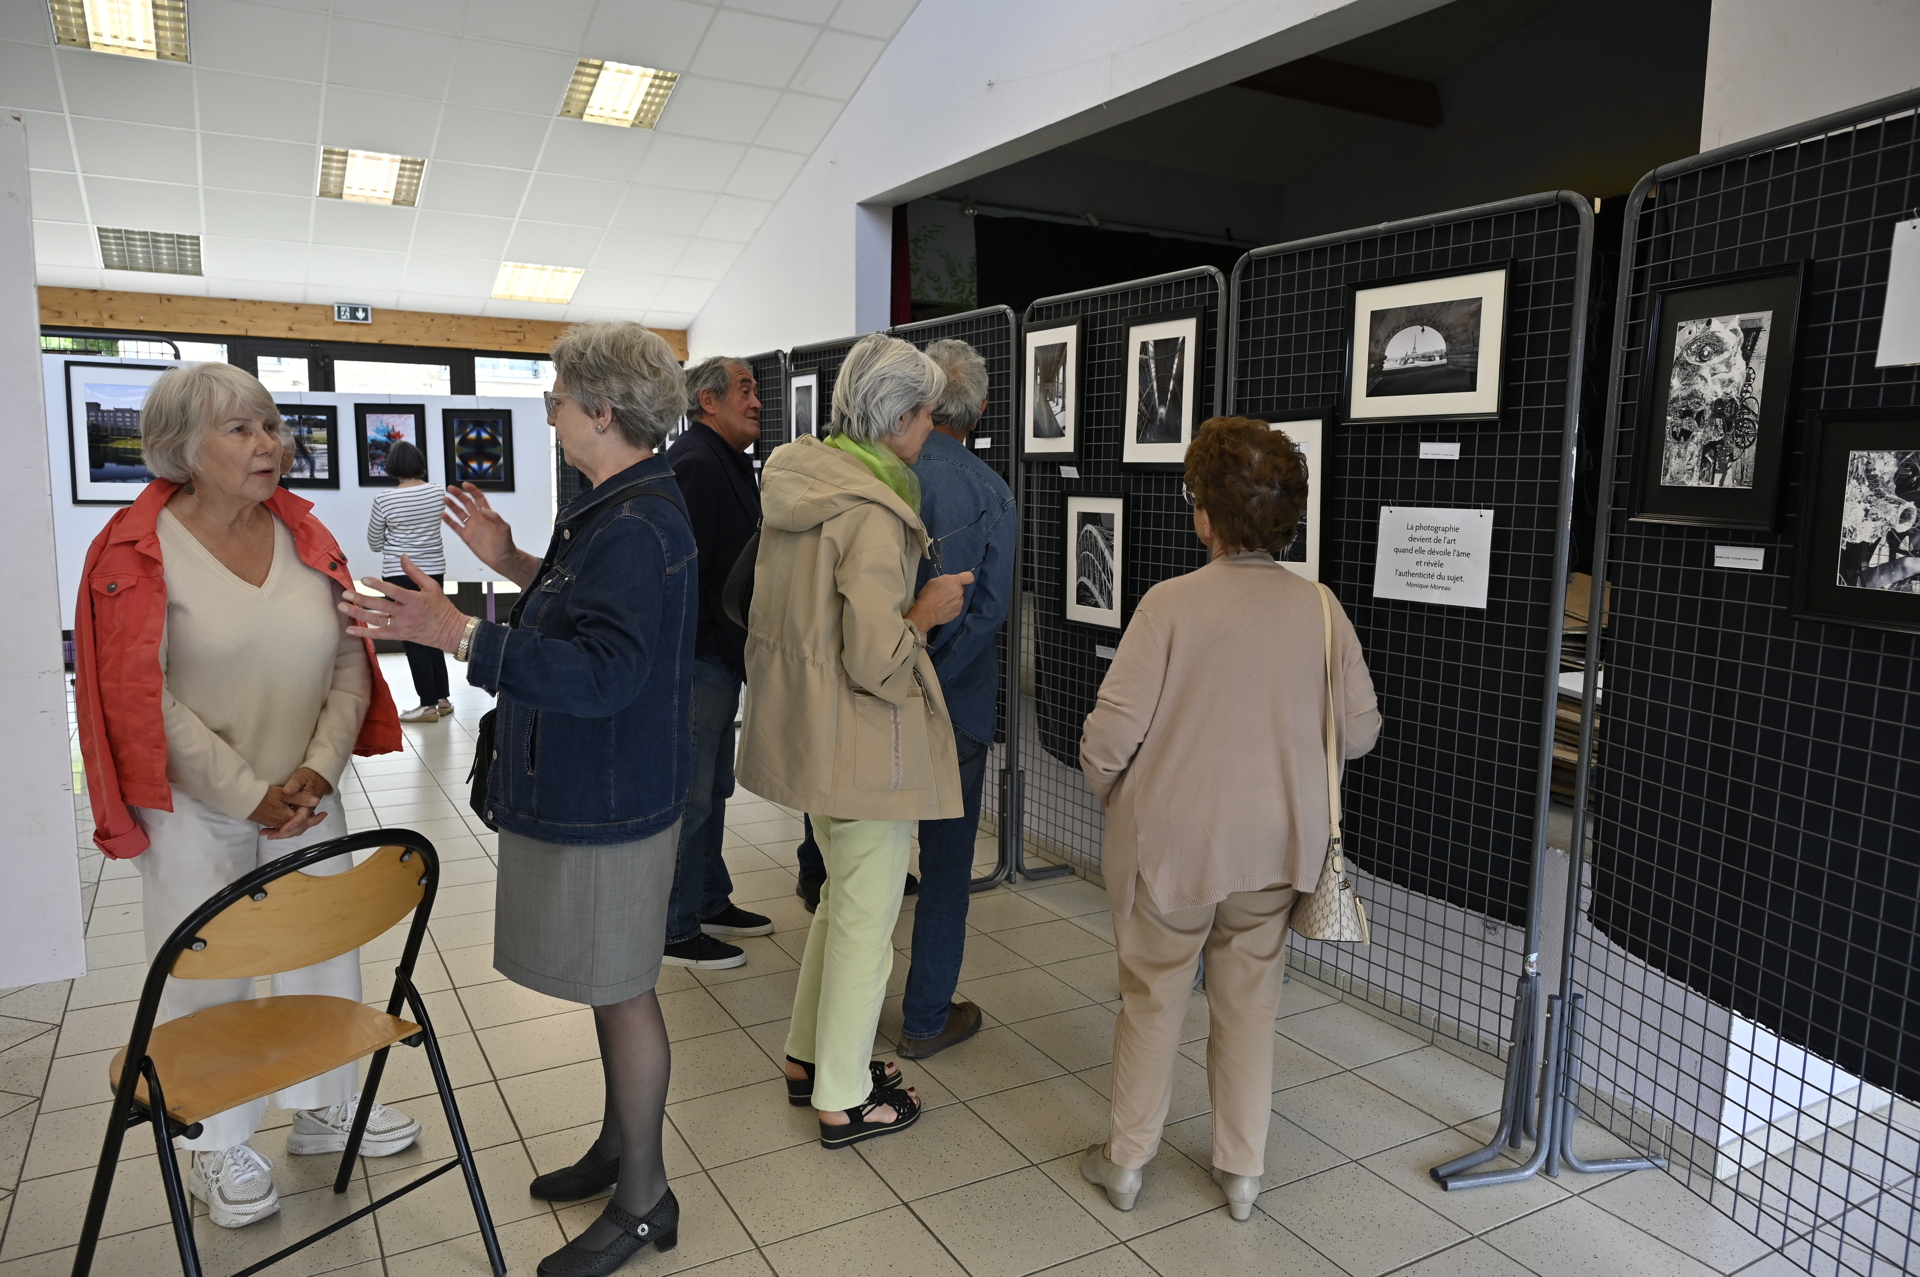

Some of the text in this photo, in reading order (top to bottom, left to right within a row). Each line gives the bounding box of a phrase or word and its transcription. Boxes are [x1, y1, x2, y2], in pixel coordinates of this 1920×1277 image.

[1415, 523, 1459, 534] photographie
[1408, 535, 1456, 544] devient de l'art
[1394, 547, 1413, 555] quand
[1427, 548, 1451, 557] dévoile
[1453, 549, 1471, 557] l'âme
[1424, 560, 1444, 568] révèle
[1395, 569, 1464, 583] l'authenticité du sujet.
[1406, 581, 1429, 589] Monique
